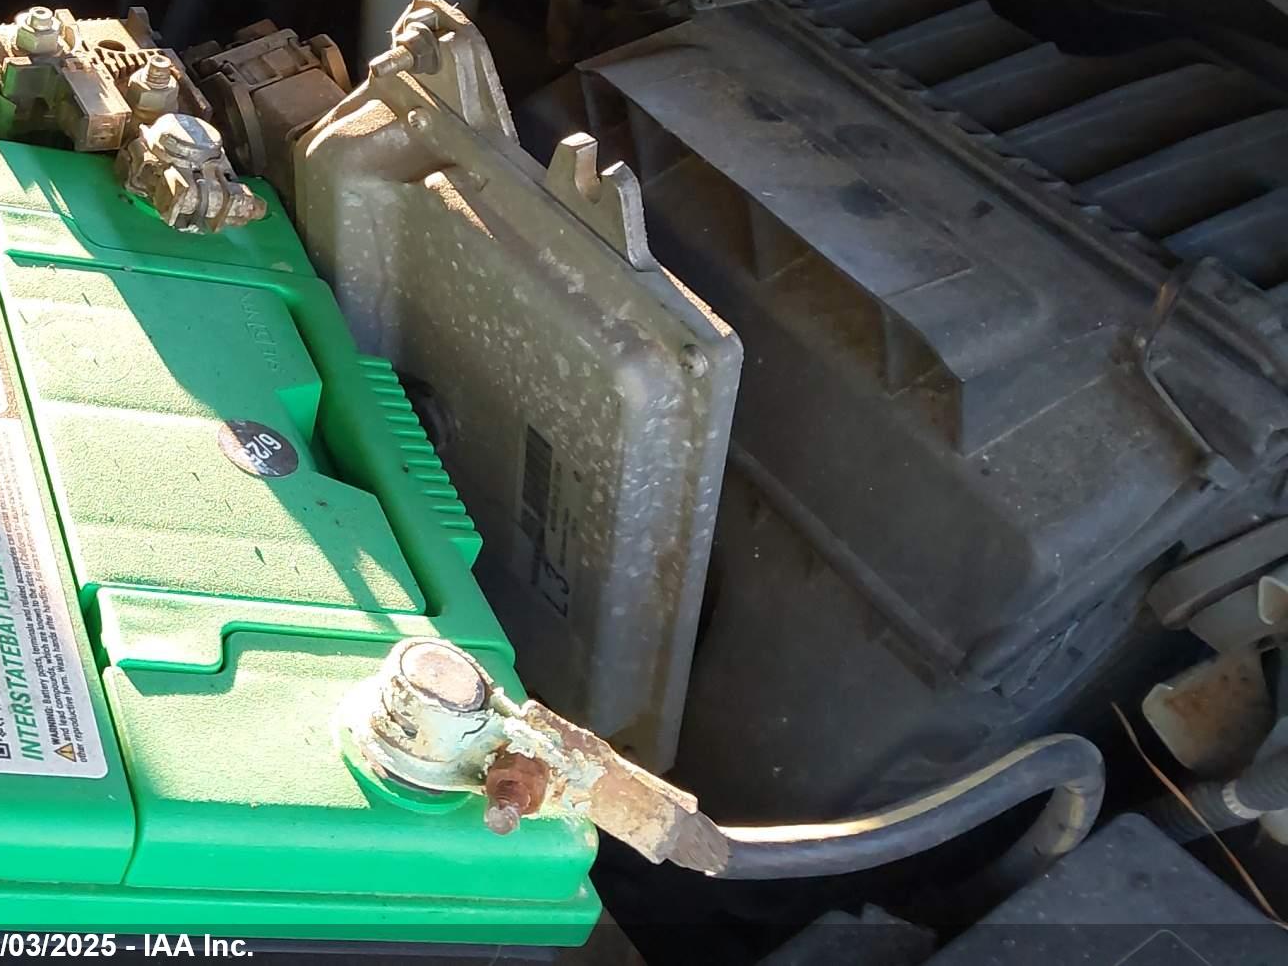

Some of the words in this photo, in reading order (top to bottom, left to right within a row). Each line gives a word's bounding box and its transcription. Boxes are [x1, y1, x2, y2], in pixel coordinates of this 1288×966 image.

[8, 546, 23, 583] accessories
[16, 585, 29, 607] related
[32, 608, 44, 629] known
[25, 622, 40, 654] terminals
[48, 632, 60, 651] hands
[39, 644, 52, 663] which
[53, 653, 65, 672] Wash
[33, 657, 46, 676] posts,
[38, 679, 53, 703] Battery
[45, 666, 66, 708] compounds,
[58, 675, 72, 694] harm.
[44, 705, 61, 744] WARNING:
[55, 710, 67, 725] lead
[63, 696, 84, 741] reproductive
[74, 743, 87, 762] other
